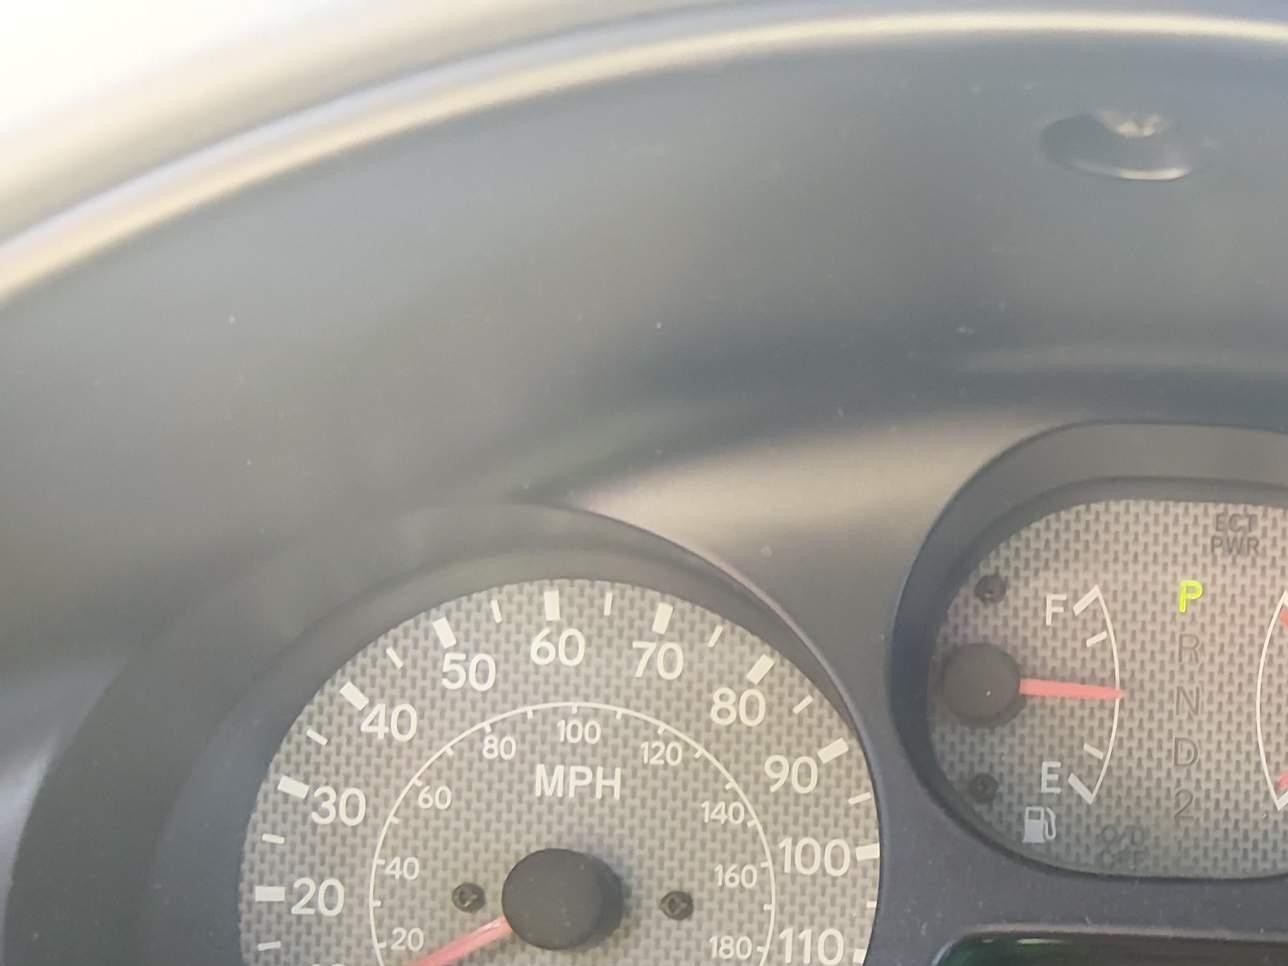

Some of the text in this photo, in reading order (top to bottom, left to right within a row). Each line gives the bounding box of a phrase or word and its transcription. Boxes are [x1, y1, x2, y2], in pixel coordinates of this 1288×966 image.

[1045, 594, 1068, 627] F
[1178, 580, 1204, 614] P
[529, 628, 587, 667] 60
[631, 640, 684, 681] 70
[1177, 633, 1200, 664] R
[440, 652, 497, 691] 50
[709, 687, 767, 728] 80
[1176, 685, 1200, 716] N
[359, 702, 418, 743] 40
[557, 720, 602, 746] 100
[482, 734, 517, 761] 80
[640, 740, 683, 767] 120
[1174, 737, 1199, 768] D
[533, 763, 623, 801] MPH
[764, 755, 819, 795] 90
[1041, 761, 1062, 795] E
[310, 786, 366, 828] 30
[417, 785, 453, 811] 60
[702, 799, 746, 825] 140
[1174, 788, 1196, 822] 2
[384, 856, 420, 881] 40
[778, 838, 852, 877] 100
[714, 864, 758, 889] 160
[290, 879, 345, 917] 20
[390, 927, 424, 952] 20
[708, 935, 752, 961] 180
[779, 928, 845, 966] 110
